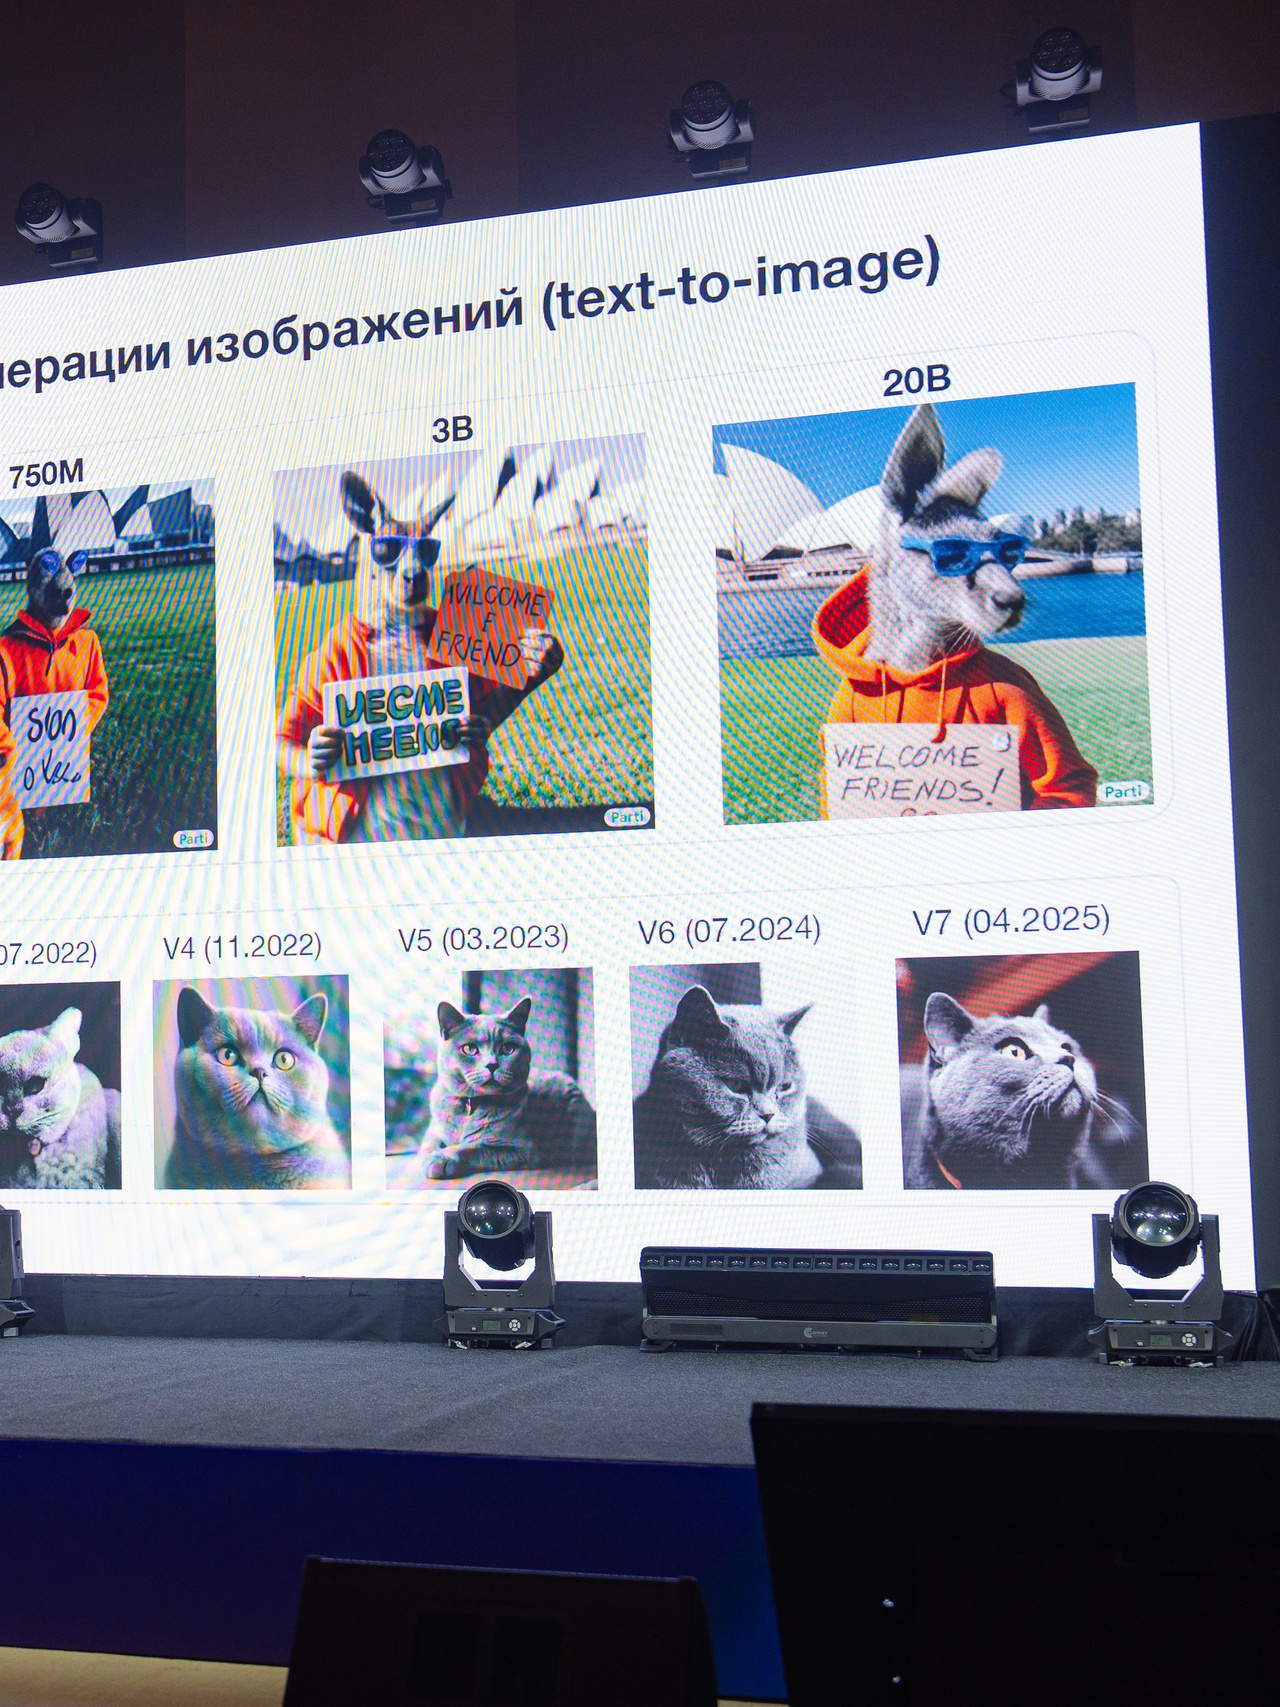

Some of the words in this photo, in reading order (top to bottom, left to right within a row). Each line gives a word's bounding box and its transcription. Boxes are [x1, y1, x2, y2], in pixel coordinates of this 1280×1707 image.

[187, 288, 523, 365] изображений
[541, 234, 941, 331] (text-to-image)
[882, 363, 952, 397] 20B
[431, 415, 474, 443] 3B
[9, 459, 85, 490] 750M
[834, 744, 982, 770] WELCOME
[841, 768, 1005, 806] FRIENDS!
[1105, 785, 1142, 799] Parti
[611, 810, 645, 824] Parti
[179, 832, 208, 845] Parti
[638, 919, 675, 944] V6
[685, 914, 822, 948] (07.2024)
[913, 909, 952, 935] V7
[964, 904, 1110, 939] (04.2025)
[163, 936, 195, 960] V4
[204, 932, 322, 964] (11.2022)
[398, 928, 432, 953] V5
[442, 923, 569, 956] (03.2023)
